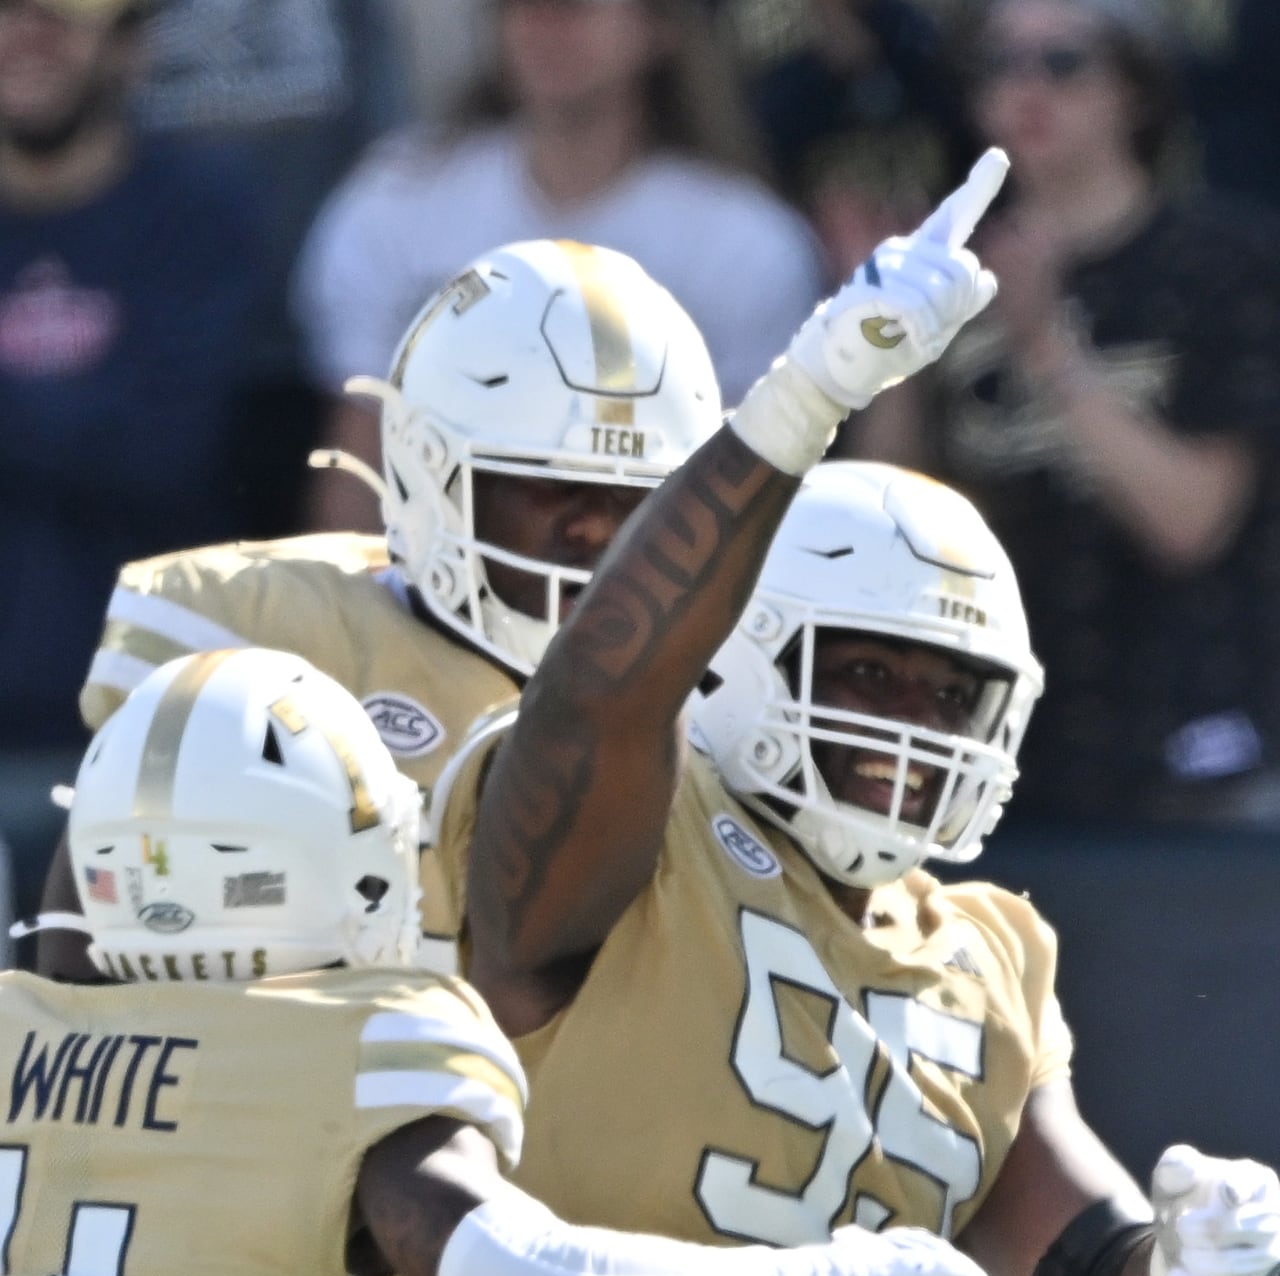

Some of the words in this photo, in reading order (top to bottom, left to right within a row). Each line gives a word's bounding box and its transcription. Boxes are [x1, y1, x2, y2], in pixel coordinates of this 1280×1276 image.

[590, 427, 645, 458] TECH
[141, 833, 170, 877] 4
[6, 1030, 200, 1133] WHITE
[693, 903, 985, 1250] 95
